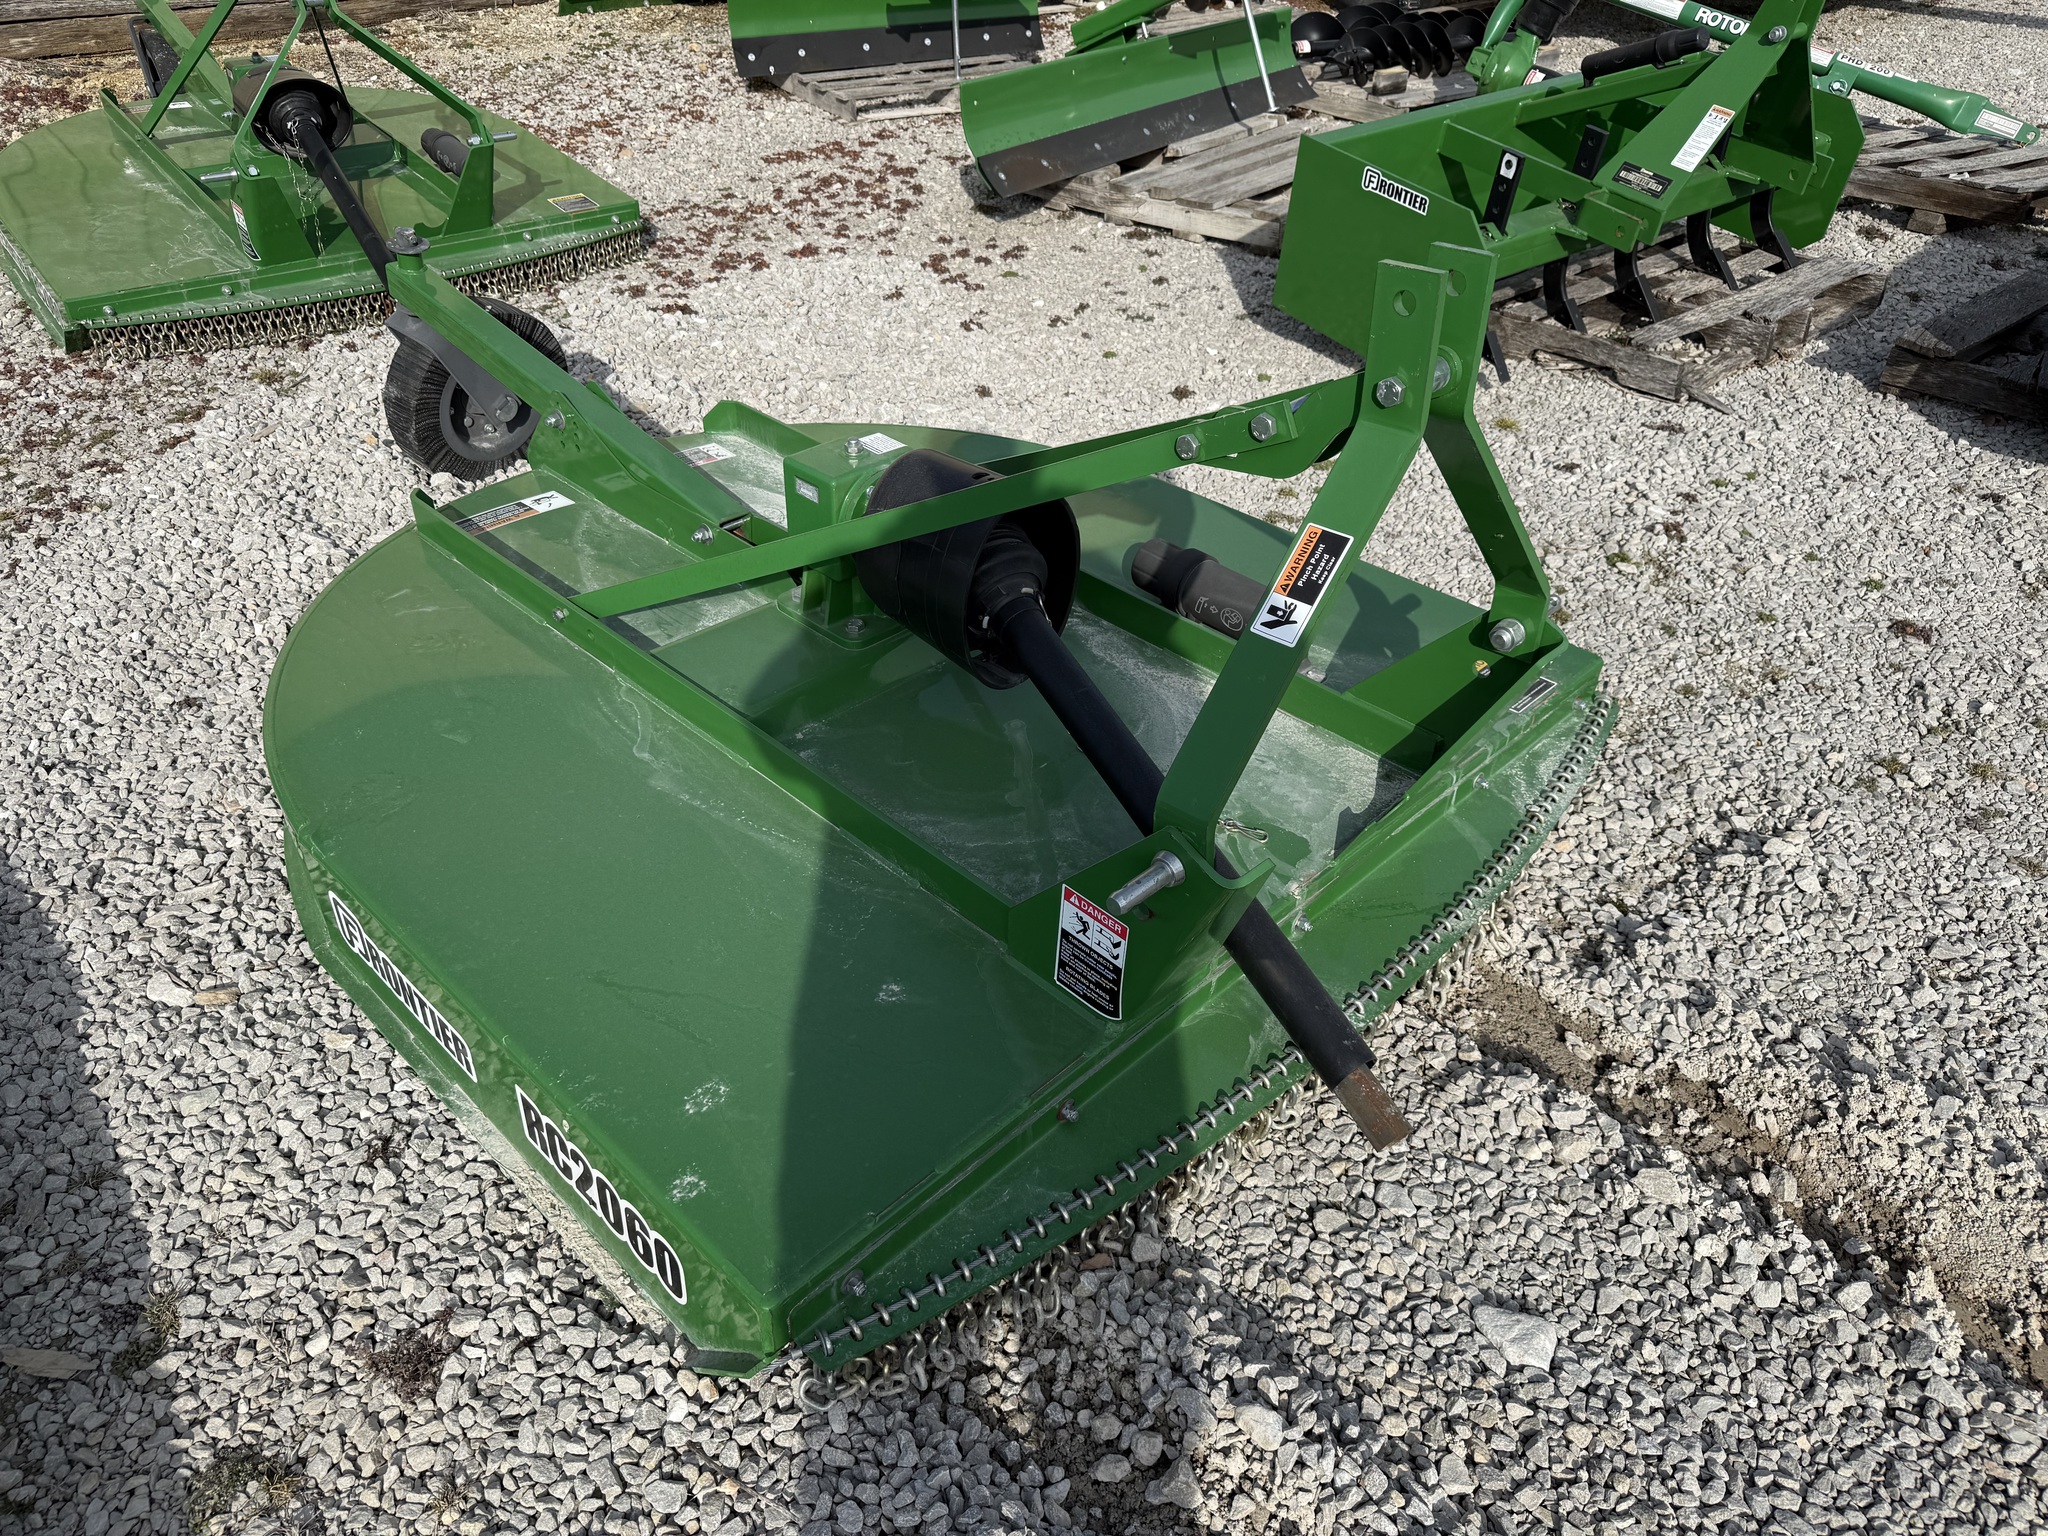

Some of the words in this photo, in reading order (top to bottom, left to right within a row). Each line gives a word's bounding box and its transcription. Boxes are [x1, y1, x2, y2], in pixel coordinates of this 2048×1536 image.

[1695, 7, 1750, 36] ROTO
[1840, 54, 1864, 66] PHD
[1869, 64, 1891, 75] 200
[1363, 168, 1428, 214] FRONTIER
[1284, 530, 1319, 585] WARNING
[1297, 565, 1314, 587] Pinch
[1310, 543, 1326, 564] Point
[1311, 553, 1330, 580] Hazard
[1318, 570, 1329, 585] Keep
[1081, 900, 1122, 934] DANGER
[332, 896, 474, 1077] FRONTIER
[519, 1092, 684, 1300] RC2060
